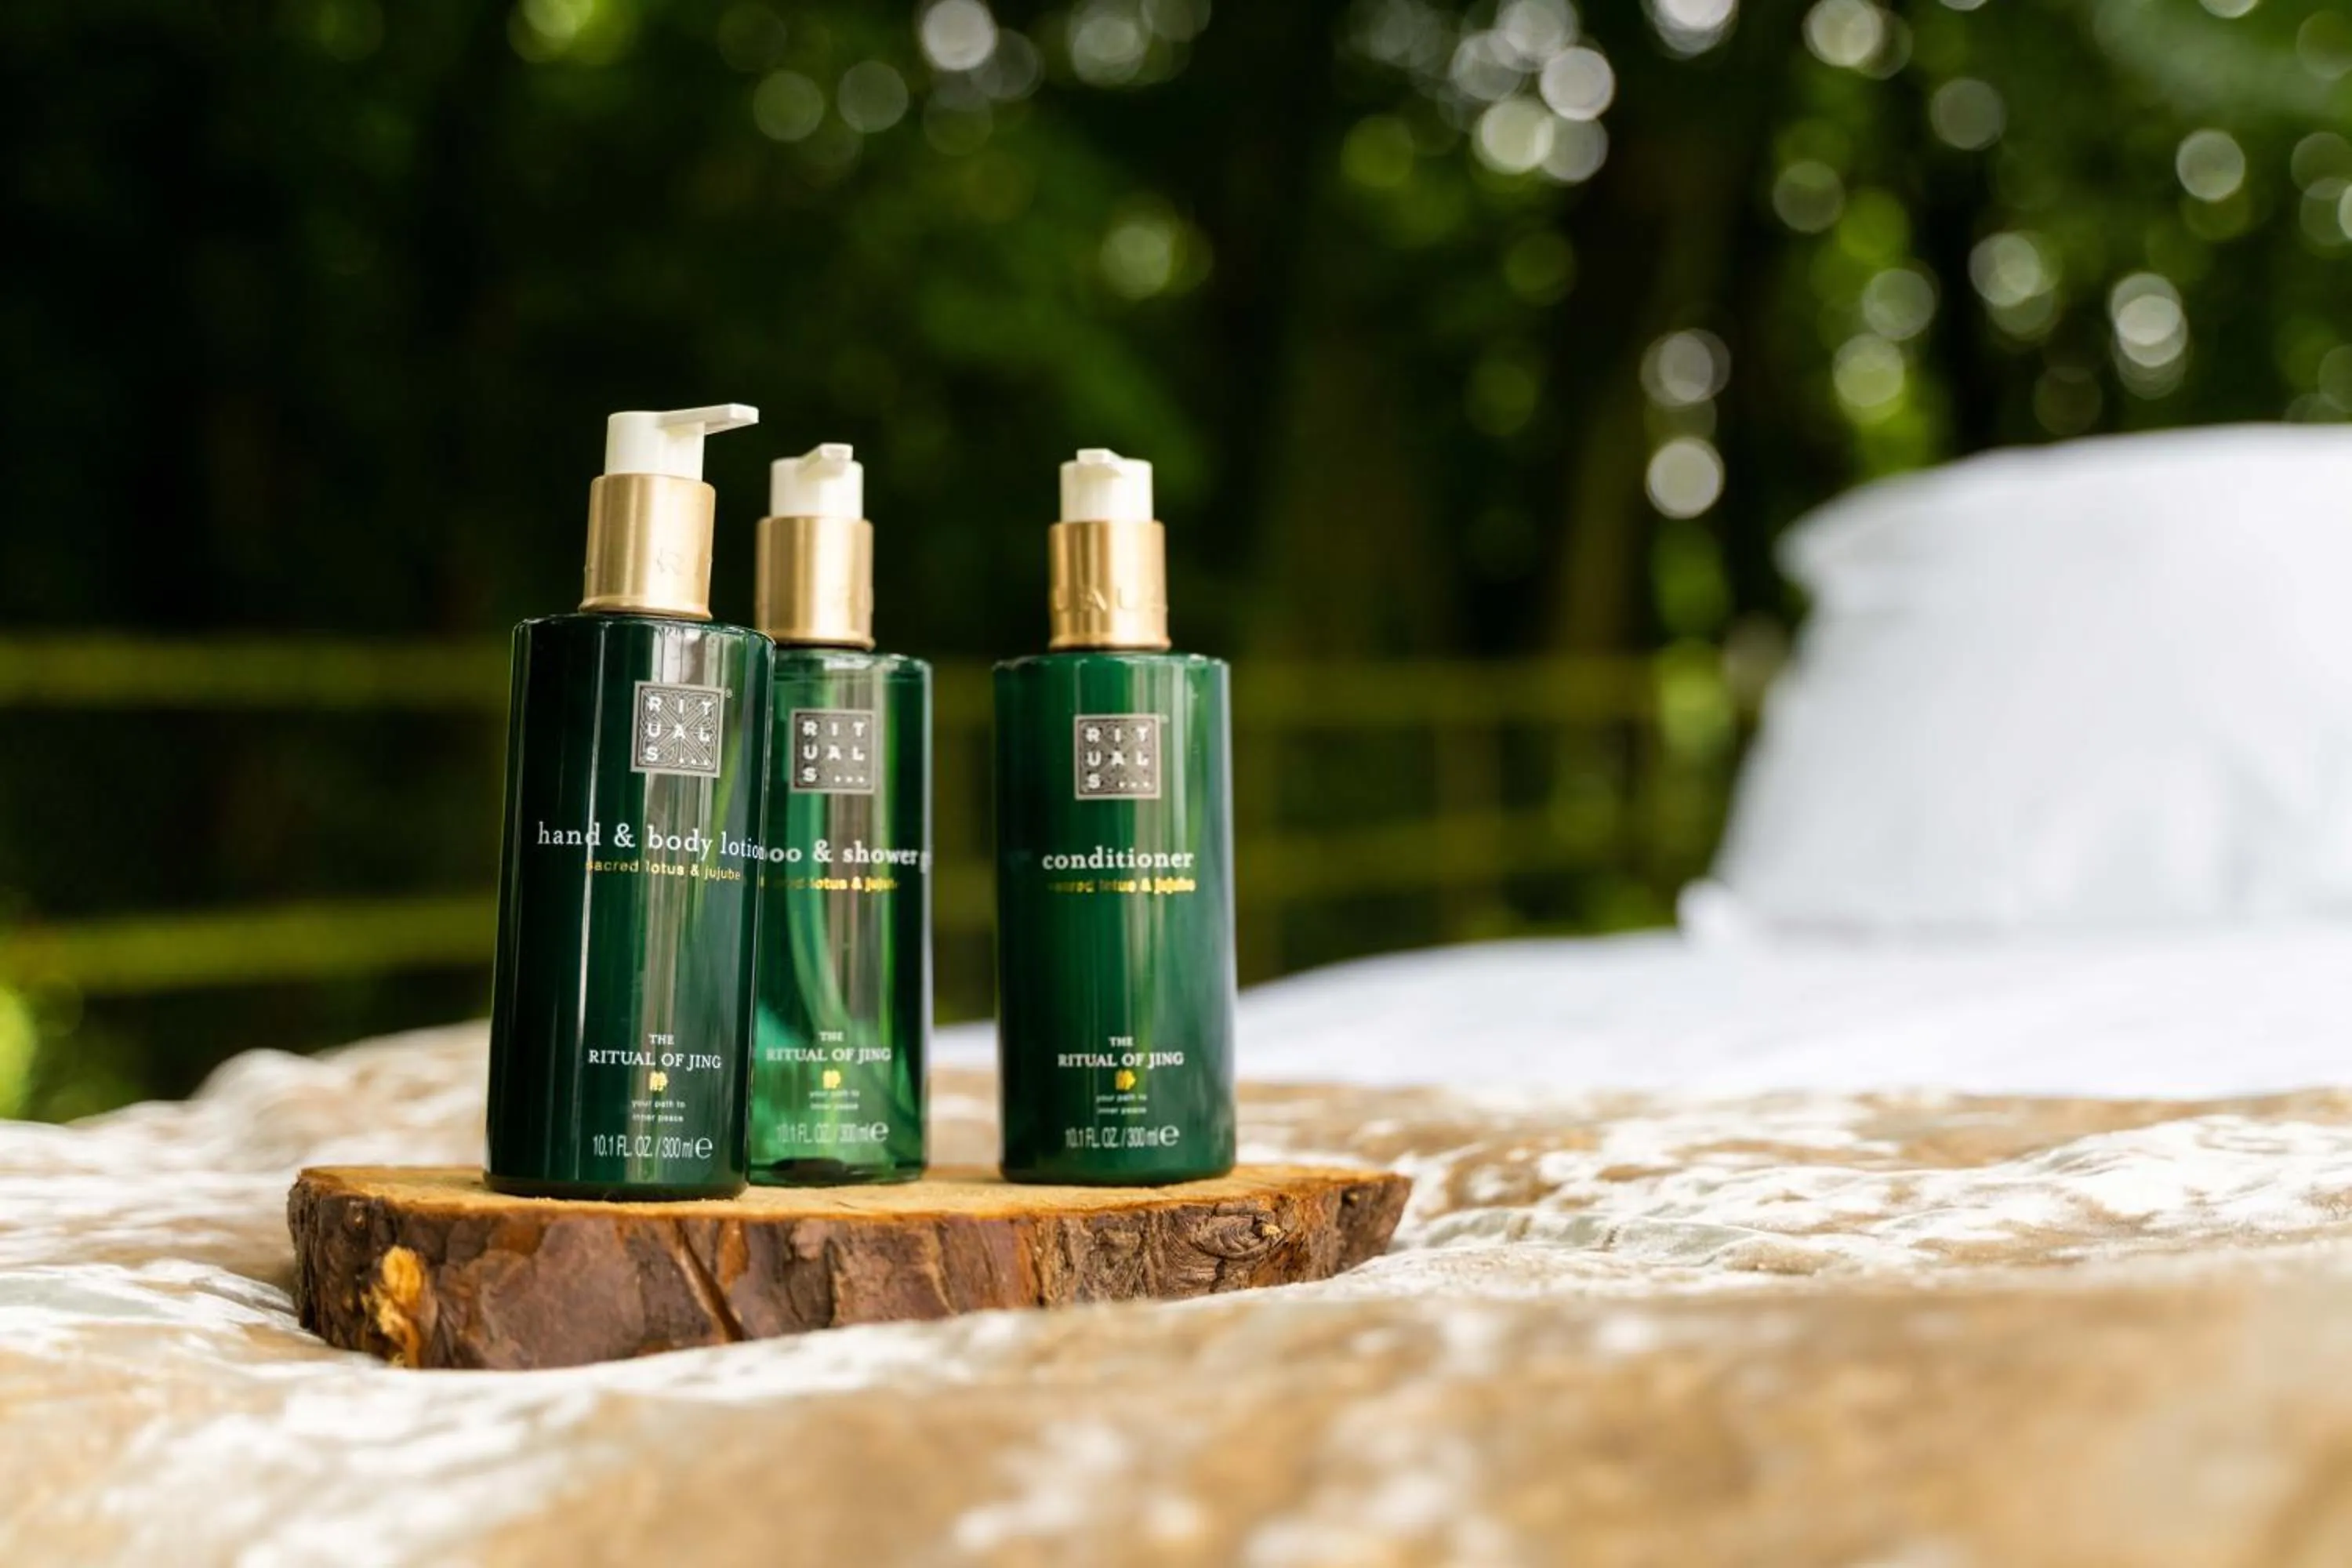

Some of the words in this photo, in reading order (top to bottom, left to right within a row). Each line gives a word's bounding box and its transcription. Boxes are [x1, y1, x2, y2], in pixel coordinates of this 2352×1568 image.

[537, 821, 601, 846] hand
[614, 822, 636, 848] &
[648, 824, 713, 861] body
[764, 847, 803, 862] oo
[812, 839, 834, 863] &
[842, 840, 919, 865] shower
[1042, 845, 1195, 869] conditioner
[586, 859, 639, 873] sacred
[645, 861, 684, 876] lotus
[690, 863, 700, 877] &
[705, 866, 741, 880] jujube
[648, 1034, 675, 1046] THE
[818, 1032, 844, 1042] THE
[1109, 1036, 1134, 1047] THE
[589, 1049, 655, 1066] RITUAL
[661, 1053, 684, 1068] OF
[686, 1055, 722, 1072] JING
[766, 1047, 828, 1062] RITUAL
[831, 1047, 855, 1062] OF
[855, 1047, 891, 1065] JING
[1058, 1054, 1117, 1067] RITUAL
[1122, 1053, 1145, 1067] OF
[1147, 1052, 1185, 1069] JING
[593, 1134, 614, 1156] 10.1
